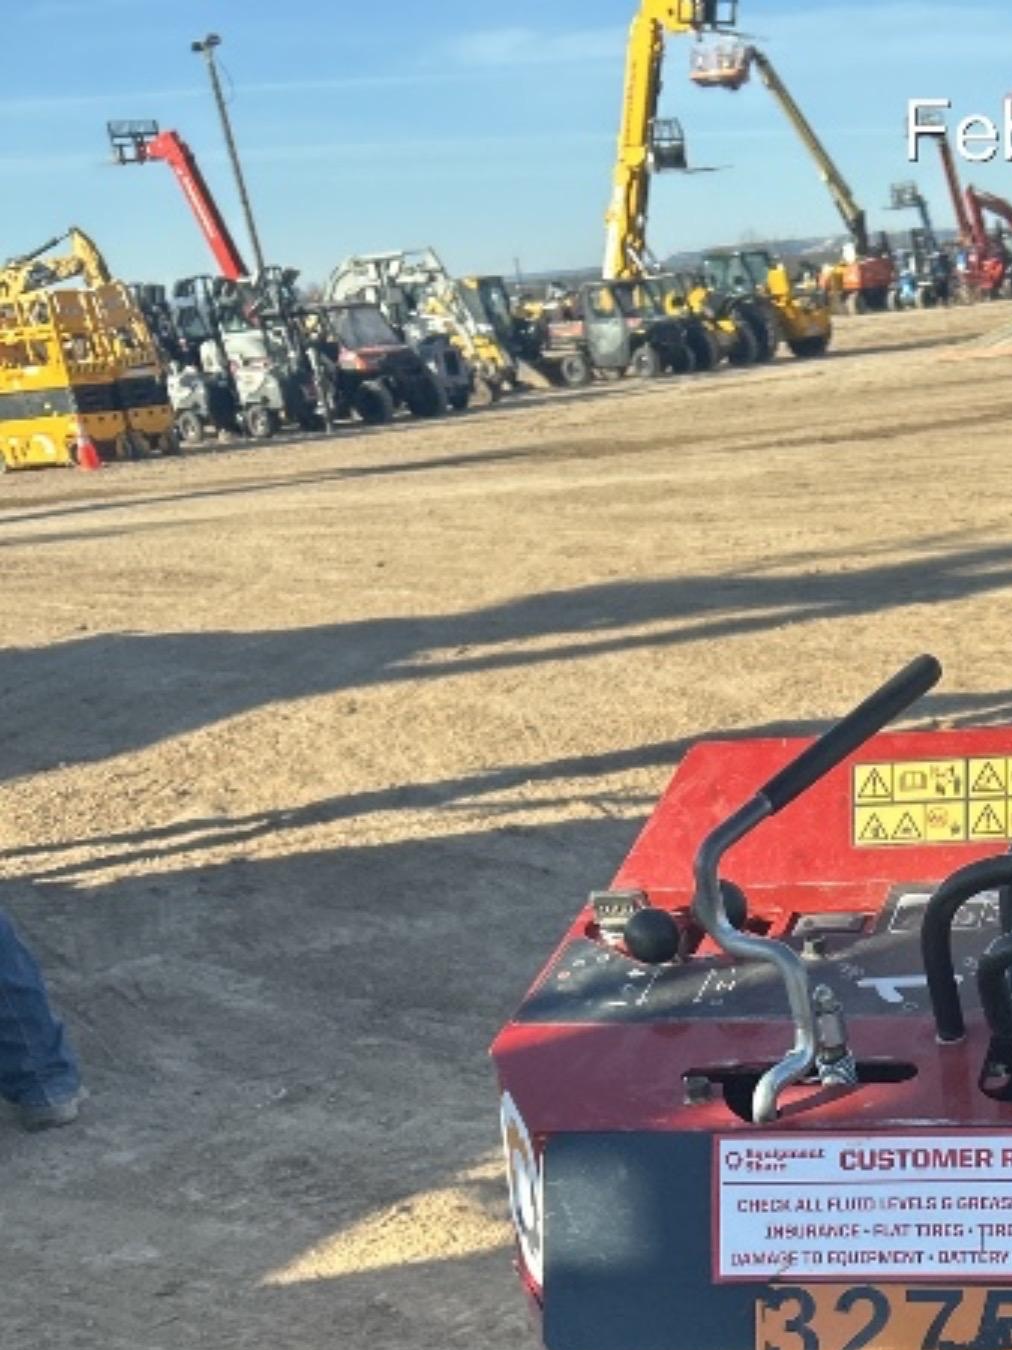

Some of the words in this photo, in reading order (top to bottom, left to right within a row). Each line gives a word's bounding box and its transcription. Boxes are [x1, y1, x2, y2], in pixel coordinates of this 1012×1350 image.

[838, 1147, 994, 1171] CUSTOMER
[736, 1198, 791, 1213] CHECK
[794, 1198, 822, 1212] ALL
[827, 1197, 876, 1212] FLUID
[765, 1223, 860, 1240] INSURANCE
[873, 1223, 910, 1238] FLAT
[915, 1223, 964, 1238] TIRES
[731, 1251, 798, 1267] DAMAGE
[803, 1251, 823, 1265] TO
[827, 1250, 924, 1267] EQUIPMENT
[938, 1251, 1009, 1265] BATTERY
